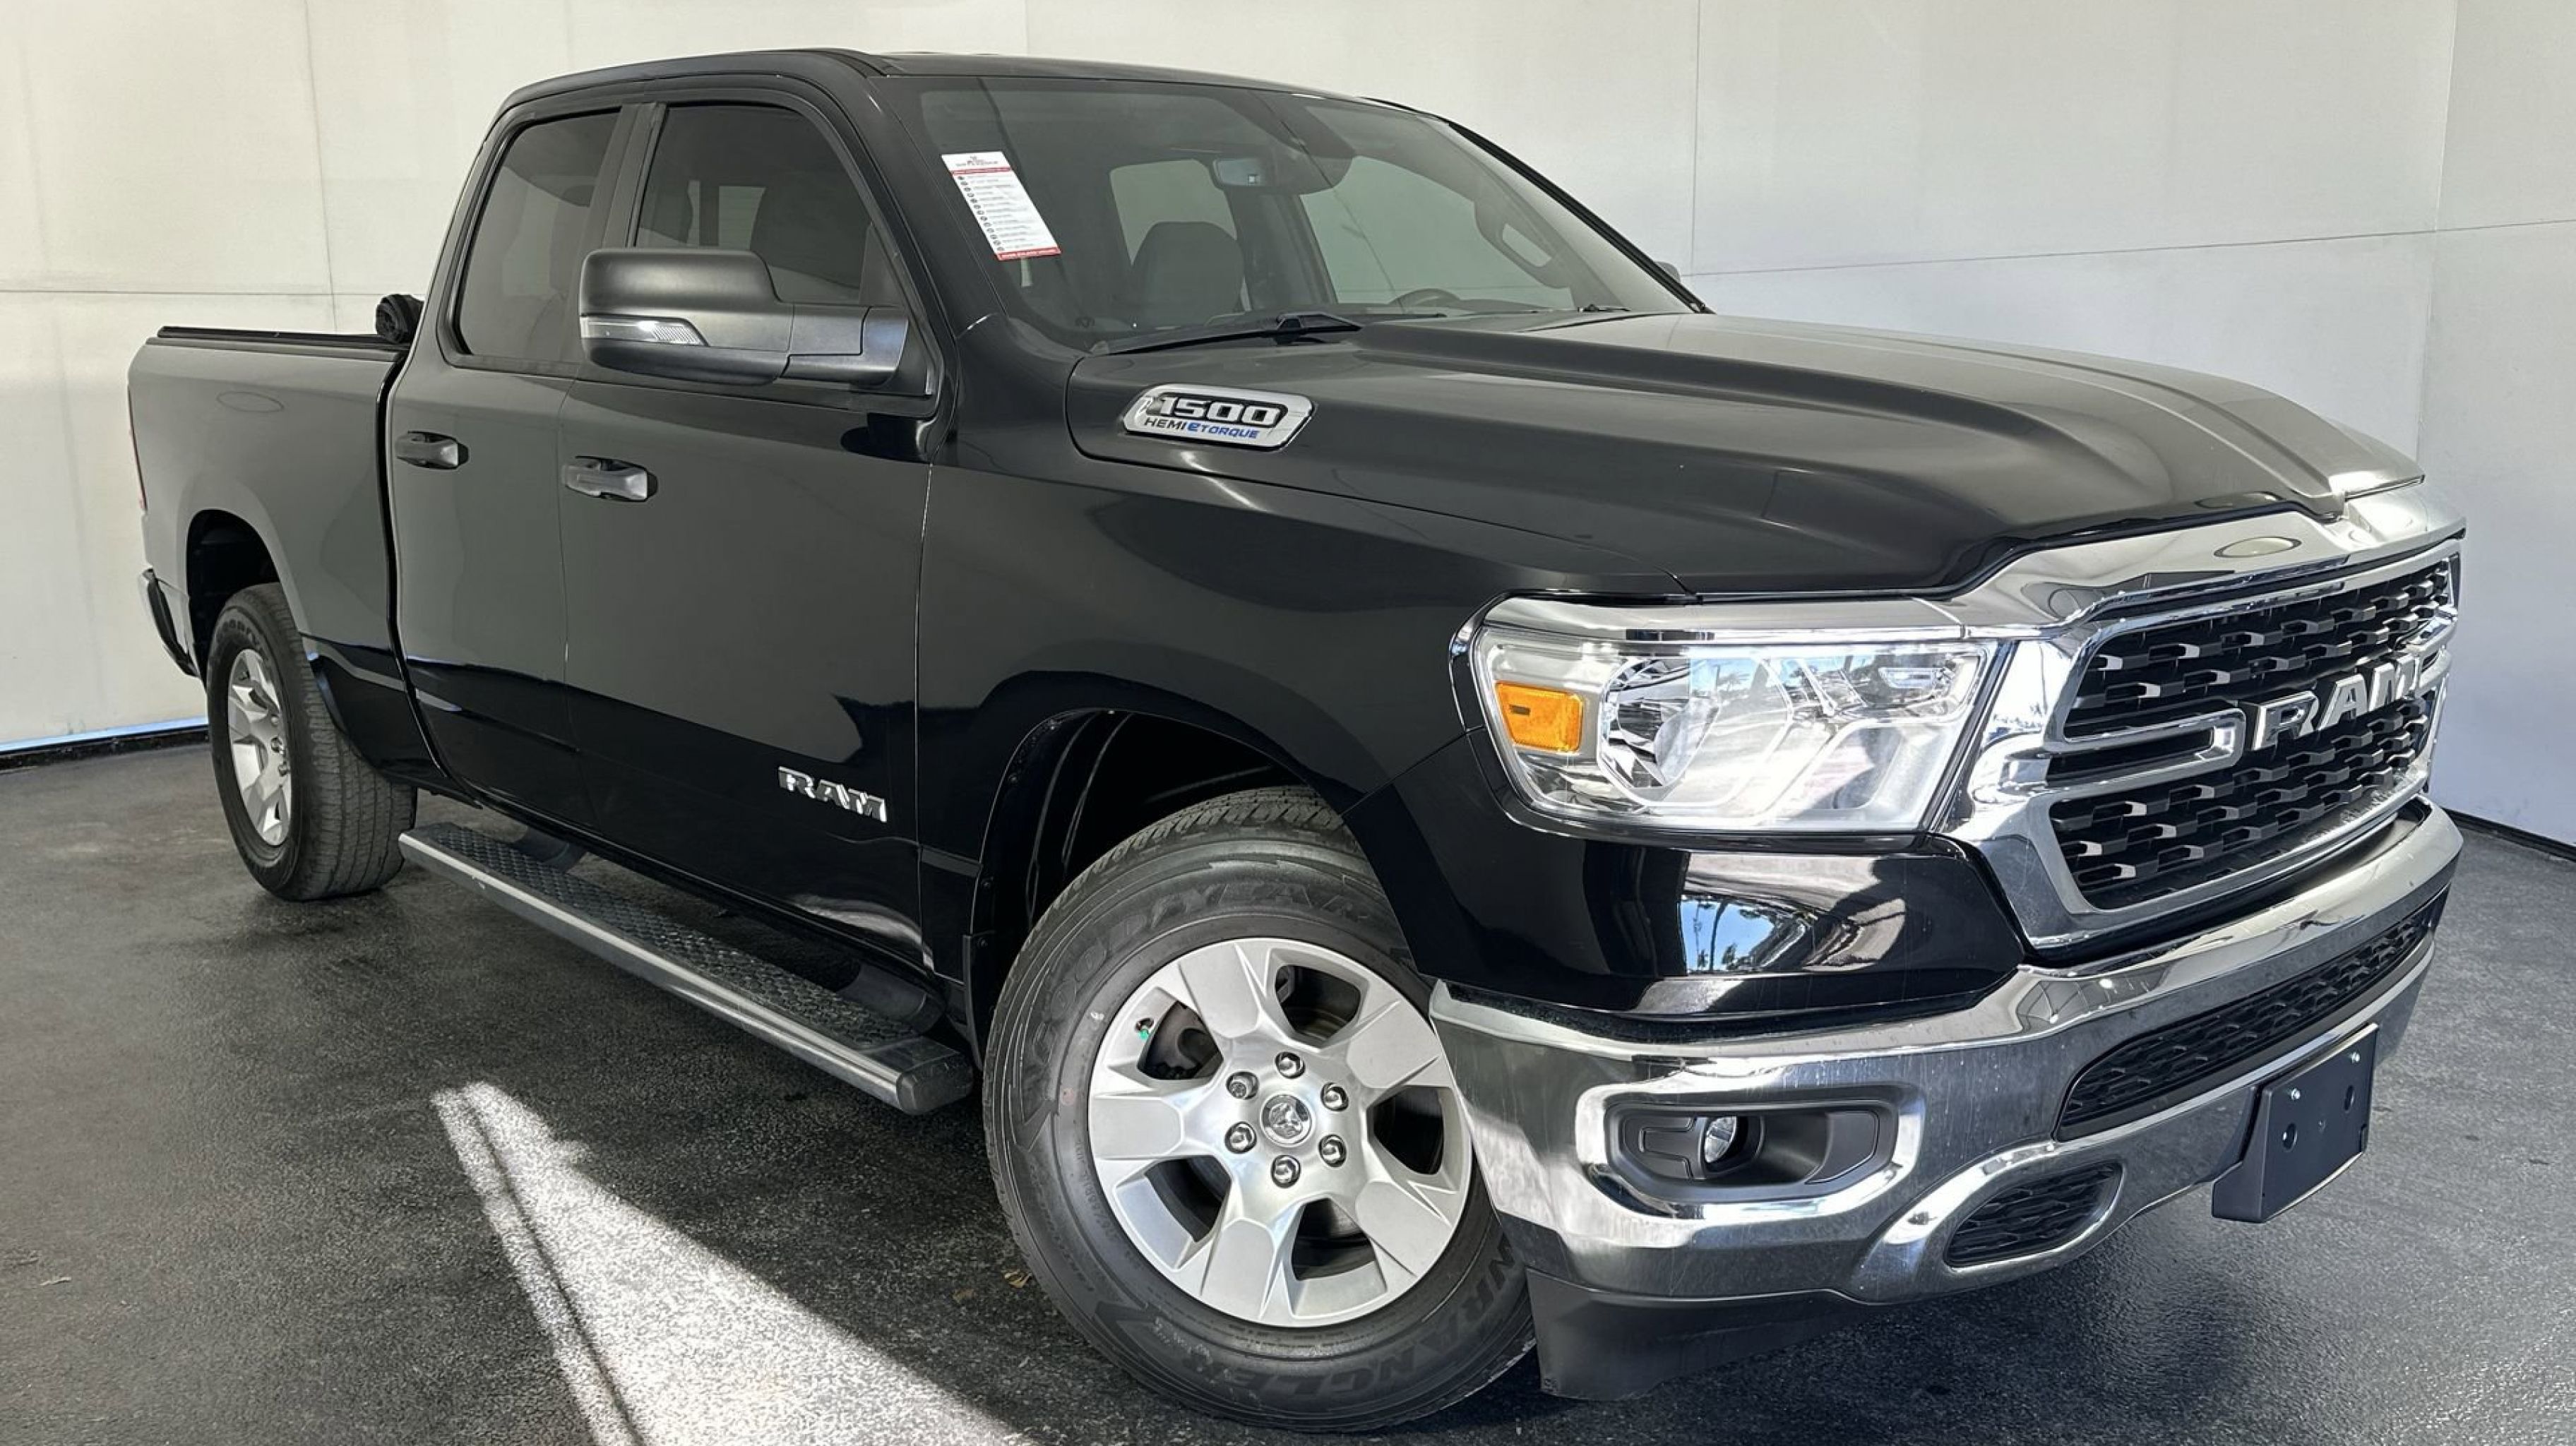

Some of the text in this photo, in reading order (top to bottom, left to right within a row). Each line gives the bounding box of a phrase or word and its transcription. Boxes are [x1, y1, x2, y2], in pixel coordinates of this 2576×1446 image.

[1144, 417, 1185, 431] HEMI
[1159, 395, 1282, 426] 1500
[2250, 652, 2420, 751] RAM
[777, 765, 888, 823] RAM
